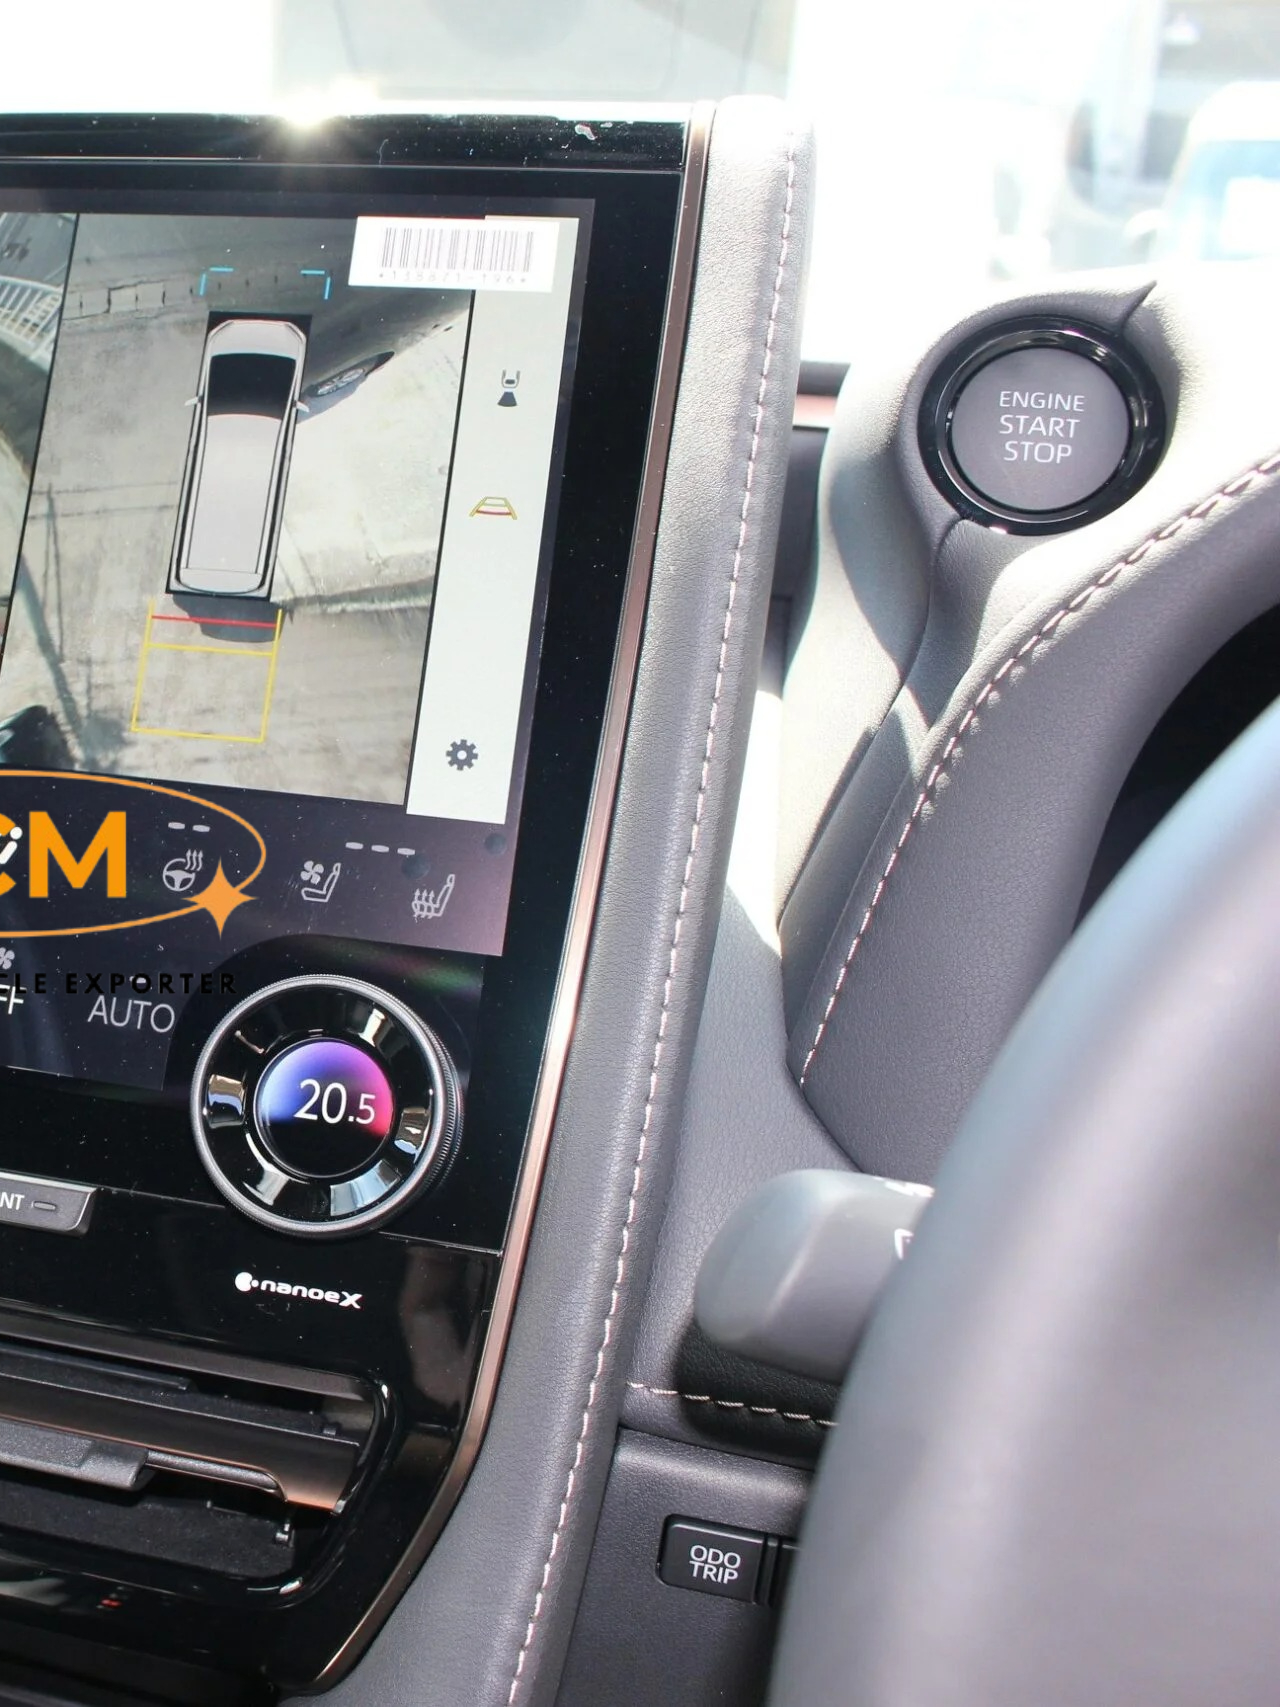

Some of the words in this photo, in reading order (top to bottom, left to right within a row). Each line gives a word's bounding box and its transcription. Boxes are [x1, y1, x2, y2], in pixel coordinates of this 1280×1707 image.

[999, 390, 1086, 412] ENGINE
[999, 414, 1081, 439] START
[1003, 440, 1072, 464] STOP
[87, 995, 175, 1033] AUTO
[293, 1078, 376, 1125] 20.5
[690, 1544, 741, 1569] ODO
[689, 1560, 739, 1585] TRIP
